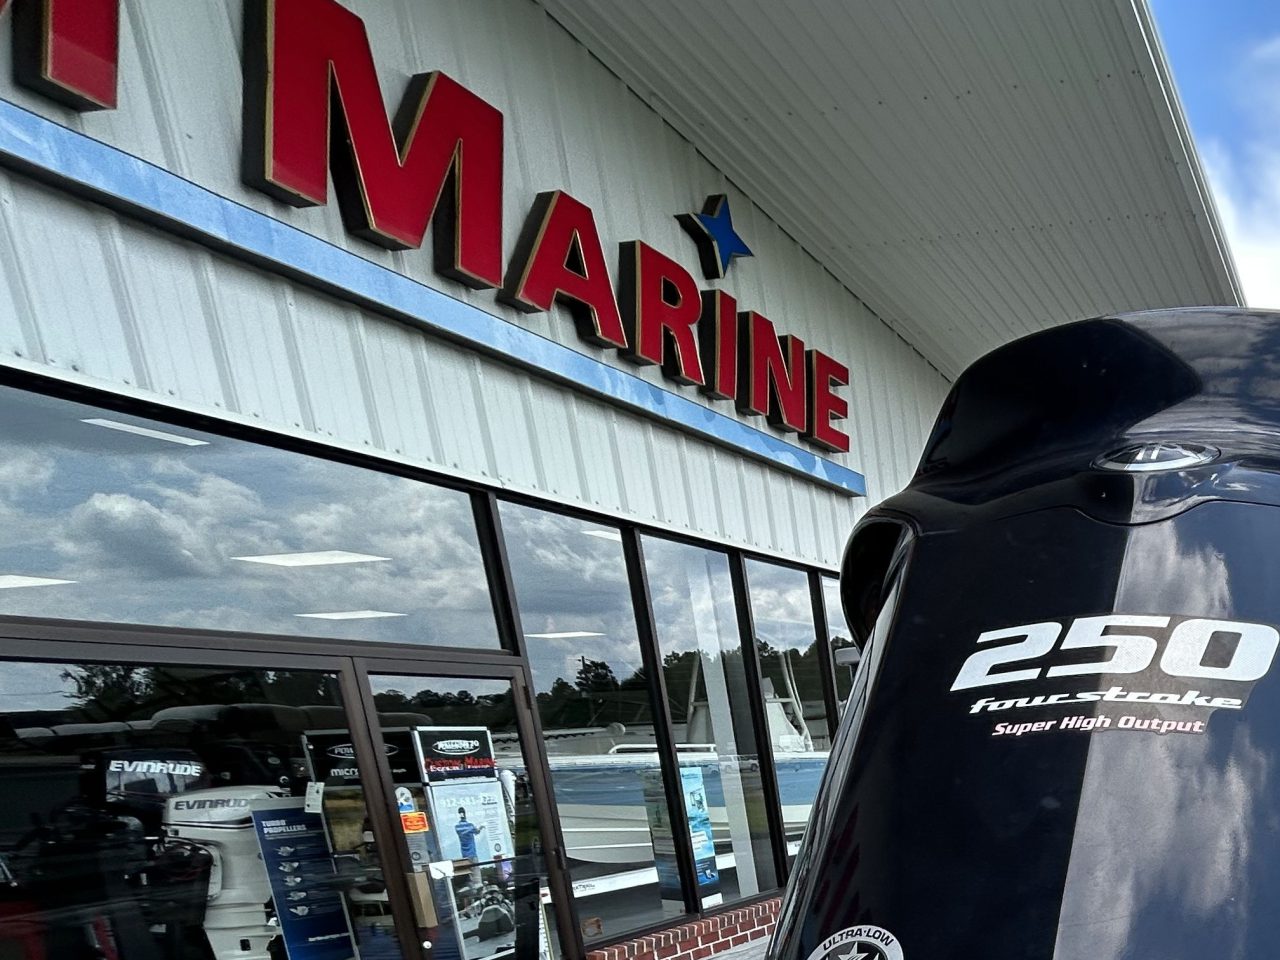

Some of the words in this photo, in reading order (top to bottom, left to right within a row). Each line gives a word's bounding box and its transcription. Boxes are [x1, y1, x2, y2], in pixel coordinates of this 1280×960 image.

[246, 0, 851, 454] MARINE
[950, 614, 1280, 692] 250
[991, 717, 1057, 737] Super
[1062, 714, 1112, 733] High
[1117, 715, 1206, 735] Output
[109, 759, 203, 776] EVINRUDE
[174, 799, 250, 811] EVINRUD
